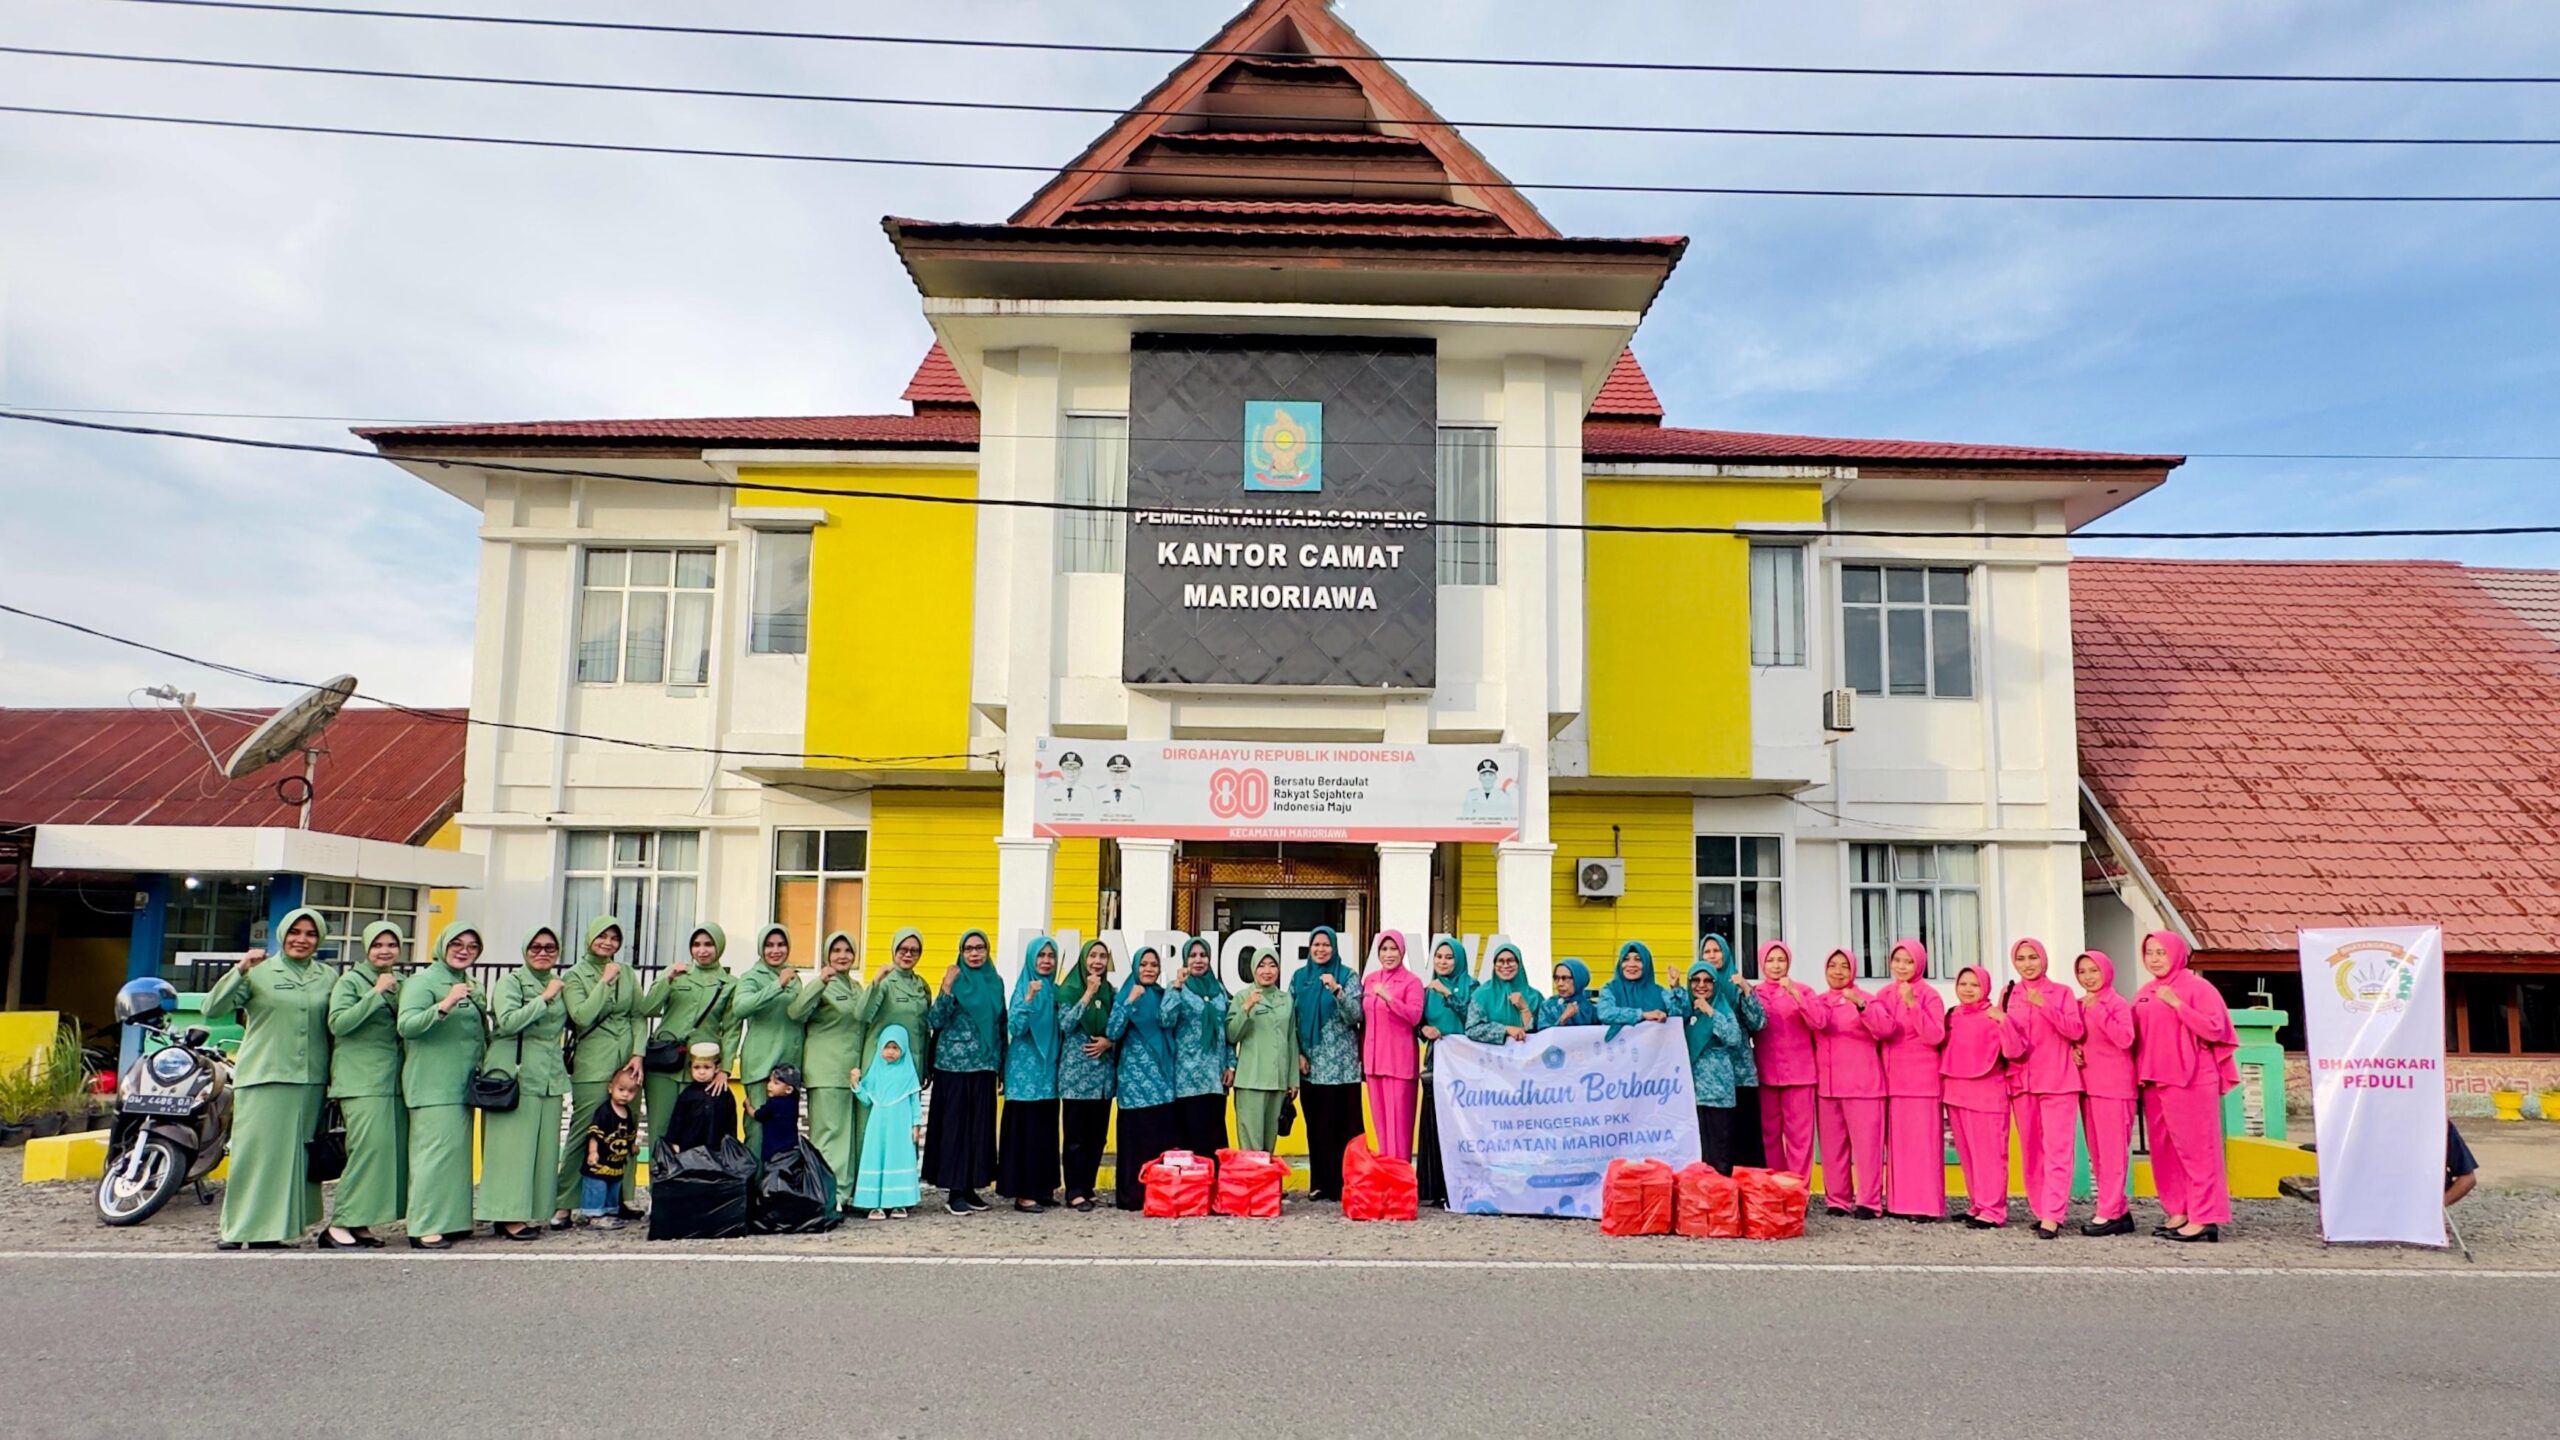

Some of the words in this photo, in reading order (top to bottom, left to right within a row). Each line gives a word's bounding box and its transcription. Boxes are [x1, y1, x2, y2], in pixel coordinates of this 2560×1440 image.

[1135, 507, 1273, 527] PEMERINTAH
[1157, 541, 1288, 567] KANTOR
[1299, 544, 1404, 569] CAMAT
[1183, 584, 1378, 610] MARIORIAWA
[1162, 748, 1251, 761] DIRGAHAYU
[1254, 748, 1330, 762] REPUBLIK
[1333, 749, 1416, 762] INDONESIA
[1274, 776, 1315, 786] Bersatu
[1318, 776, 1369, 787] Berdaulat
[1209, 767, 1270, 819] 80
[1274, 789, 1311, 801] Rakyat
[1313, 789, 1364, 801] Sejahtera
[1274, 802, 1325, 812] Indonesia
[1327, 802, 1352, 813] Maju
[1230, 828, 1287, 838] KECAMATAN
[1289, 829, 1347, 839] MARIORIAWA
[2318, 1058, 2436, 1071] BHAYANGKARI
[1448, 1079, 1576, 1108] Ramadhan
[1580, 1066, 1683, 1105] Berbagi
[2343, 1075, 2414, 1089] PEDULI
[1491, 1119, 1514, 1131] TIM
[1517, 1117, 1599, 1130] PENGGERAK
[1604, 1113, 1630, 1125] PKK
[1457, 1136, 1557, 1153] KECAMATAN
[1562, 1129, 1676, 1150] MARIORIAWA
